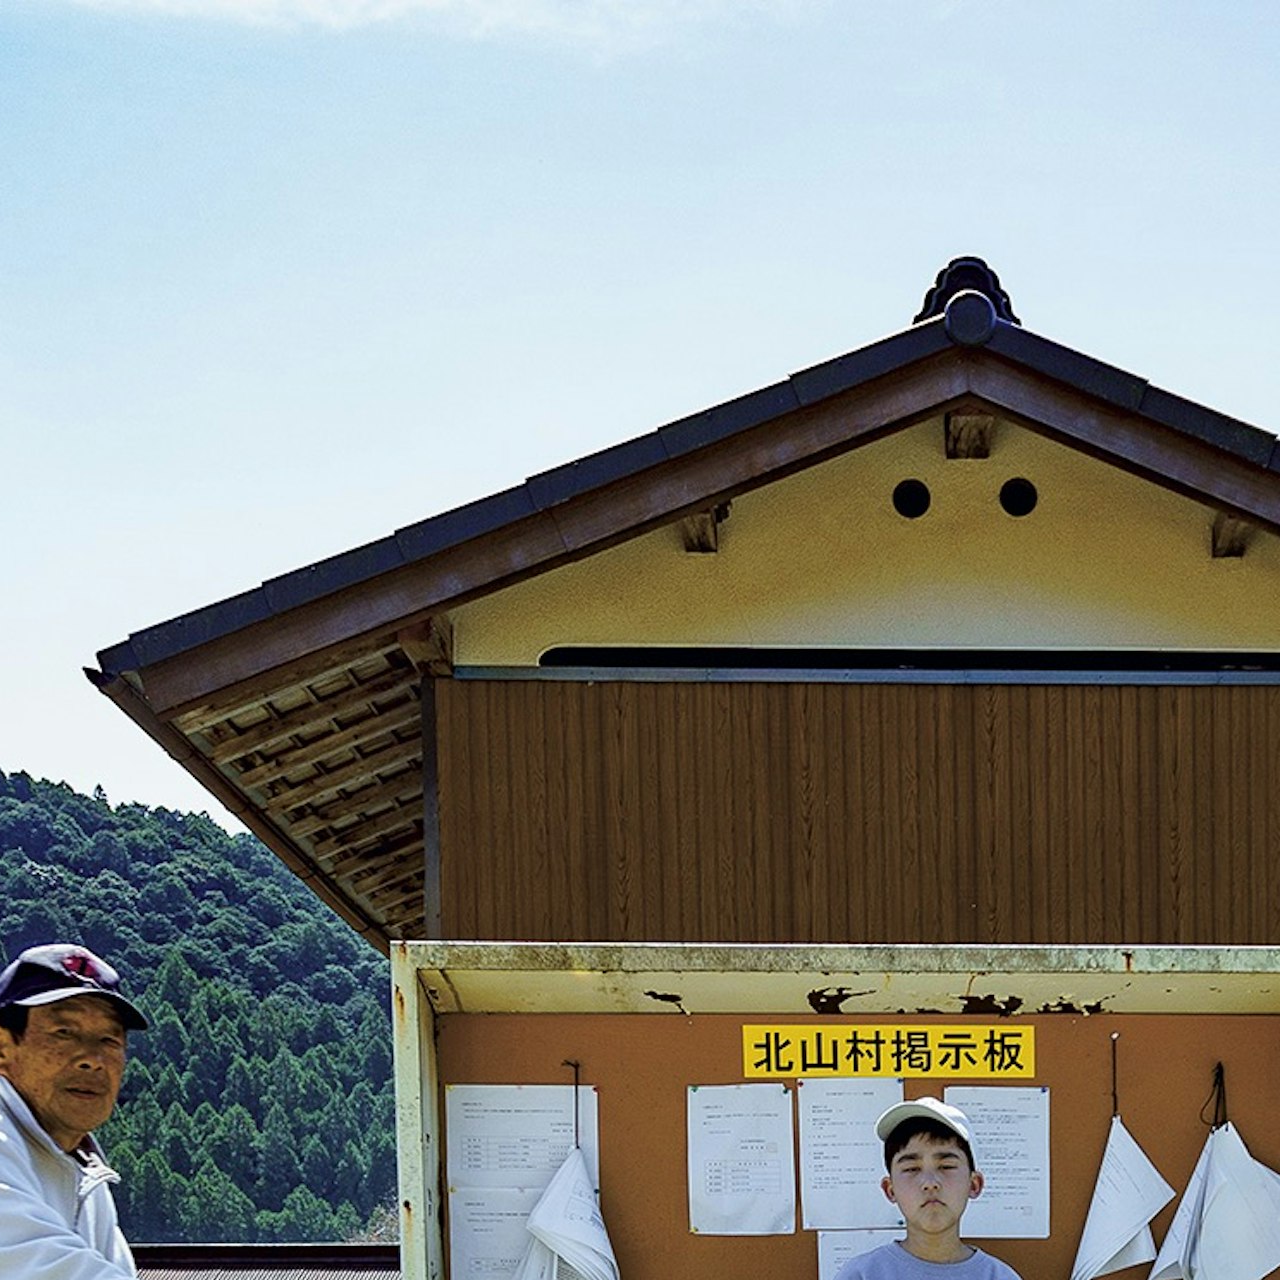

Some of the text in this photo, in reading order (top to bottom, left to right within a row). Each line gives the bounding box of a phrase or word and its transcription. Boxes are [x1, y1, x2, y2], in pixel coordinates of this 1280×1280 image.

[753, 1029, 1024, 1072] 北山村掲示板
